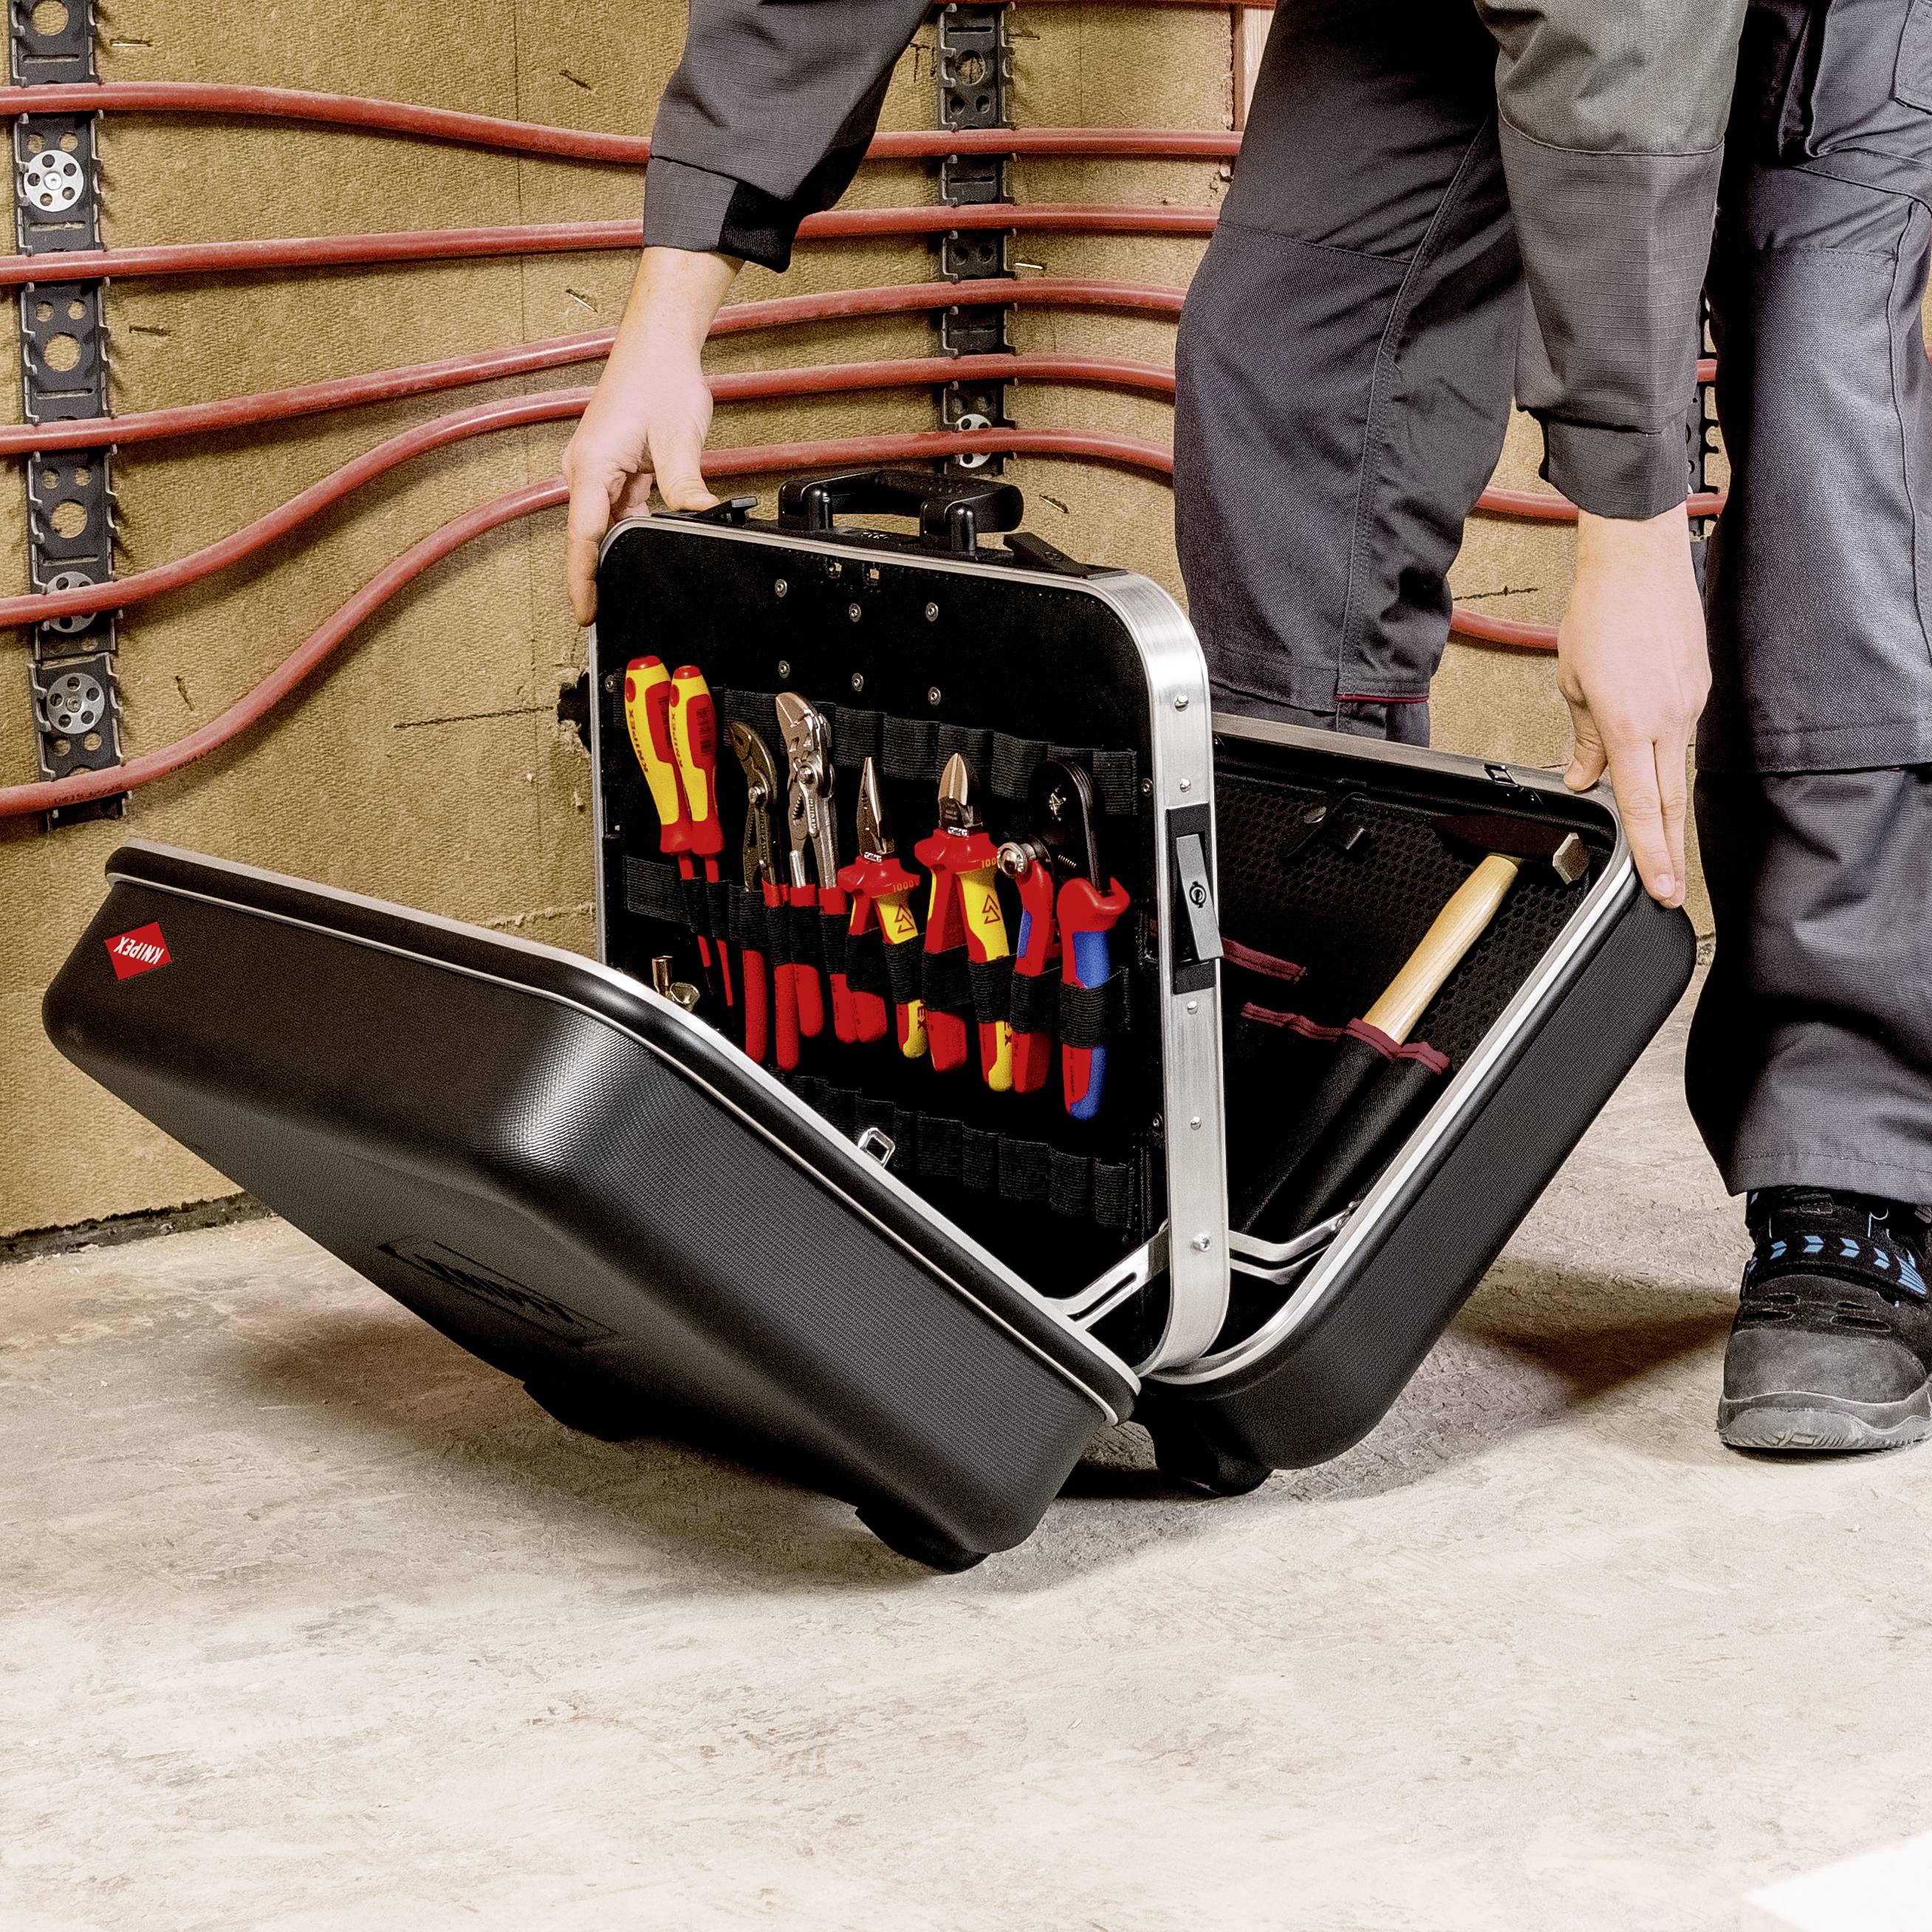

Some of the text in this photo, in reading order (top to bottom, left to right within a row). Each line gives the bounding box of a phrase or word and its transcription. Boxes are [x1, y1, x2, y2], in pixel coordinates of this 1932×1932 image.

[628, 709, 648, 773] KNIPEX
[981, 857, 997, 869] 100
[113, 936, 165, 965] KNIPEX
